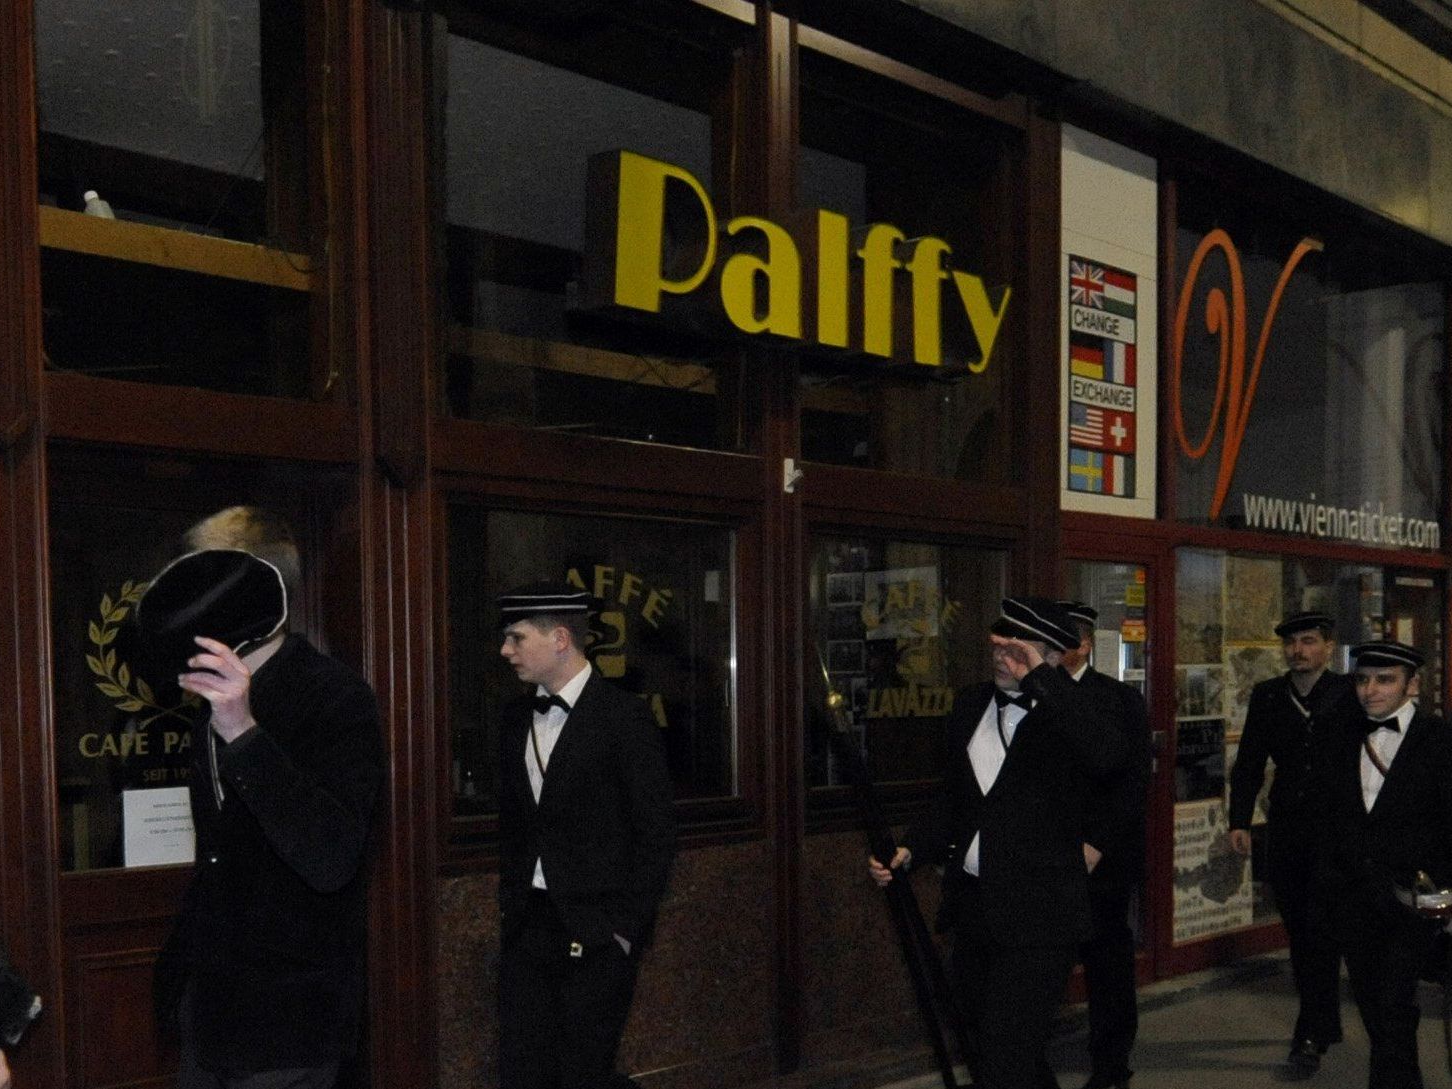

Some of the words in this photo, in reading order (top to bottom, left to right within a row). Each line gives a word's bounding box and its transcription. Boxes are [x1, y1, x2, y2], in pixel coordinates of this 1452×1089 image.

[614, 150, 1012, 375] Palffy
[1073, 309, 1120, 336] CHANGE
[1071, 380, 1133, 408] EXCHANGE
[1242, 492, 1441, 550] www.viennaticket.com
[566, 564, 675, 628] AFFÉ
